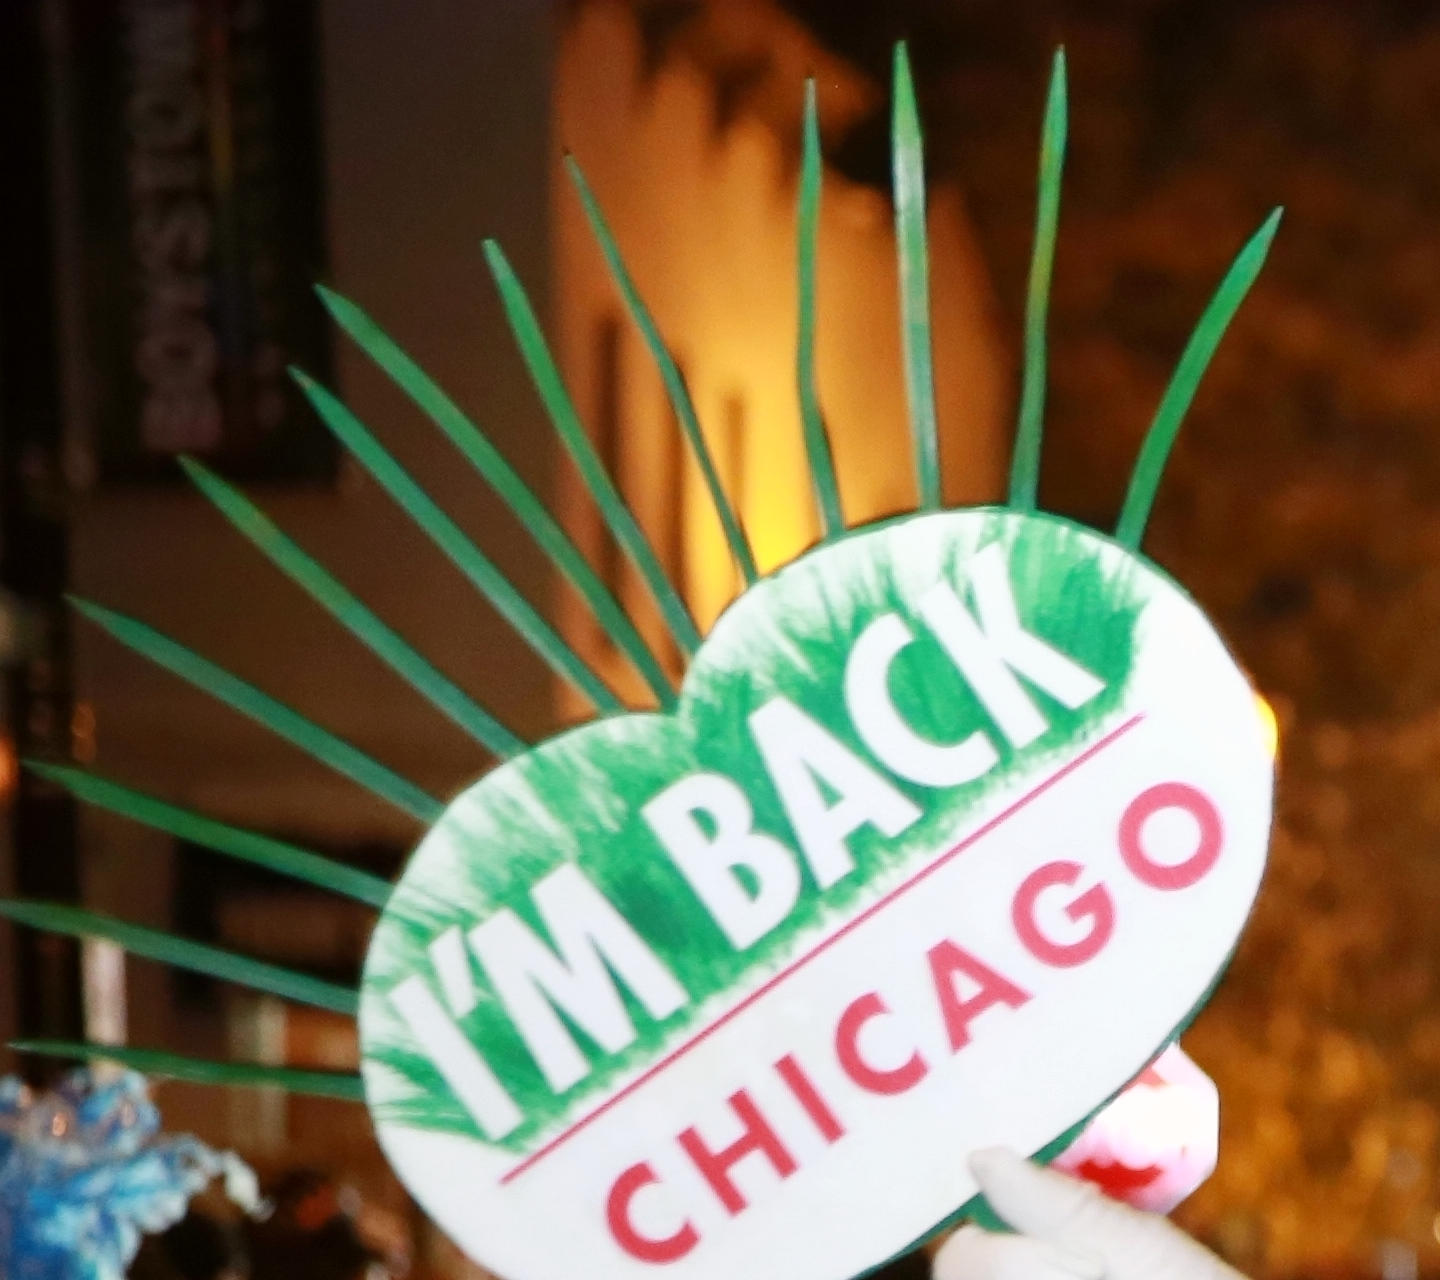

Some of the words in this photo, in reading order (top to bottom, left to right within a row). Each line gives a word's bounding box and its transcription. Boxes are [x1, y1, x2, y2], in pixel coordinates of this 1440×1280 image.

[386, 860, 690, 1142] I'M
[640, 541, 1106, 951] BACK
[604, 781, 1225, 1266] CHICAGO
